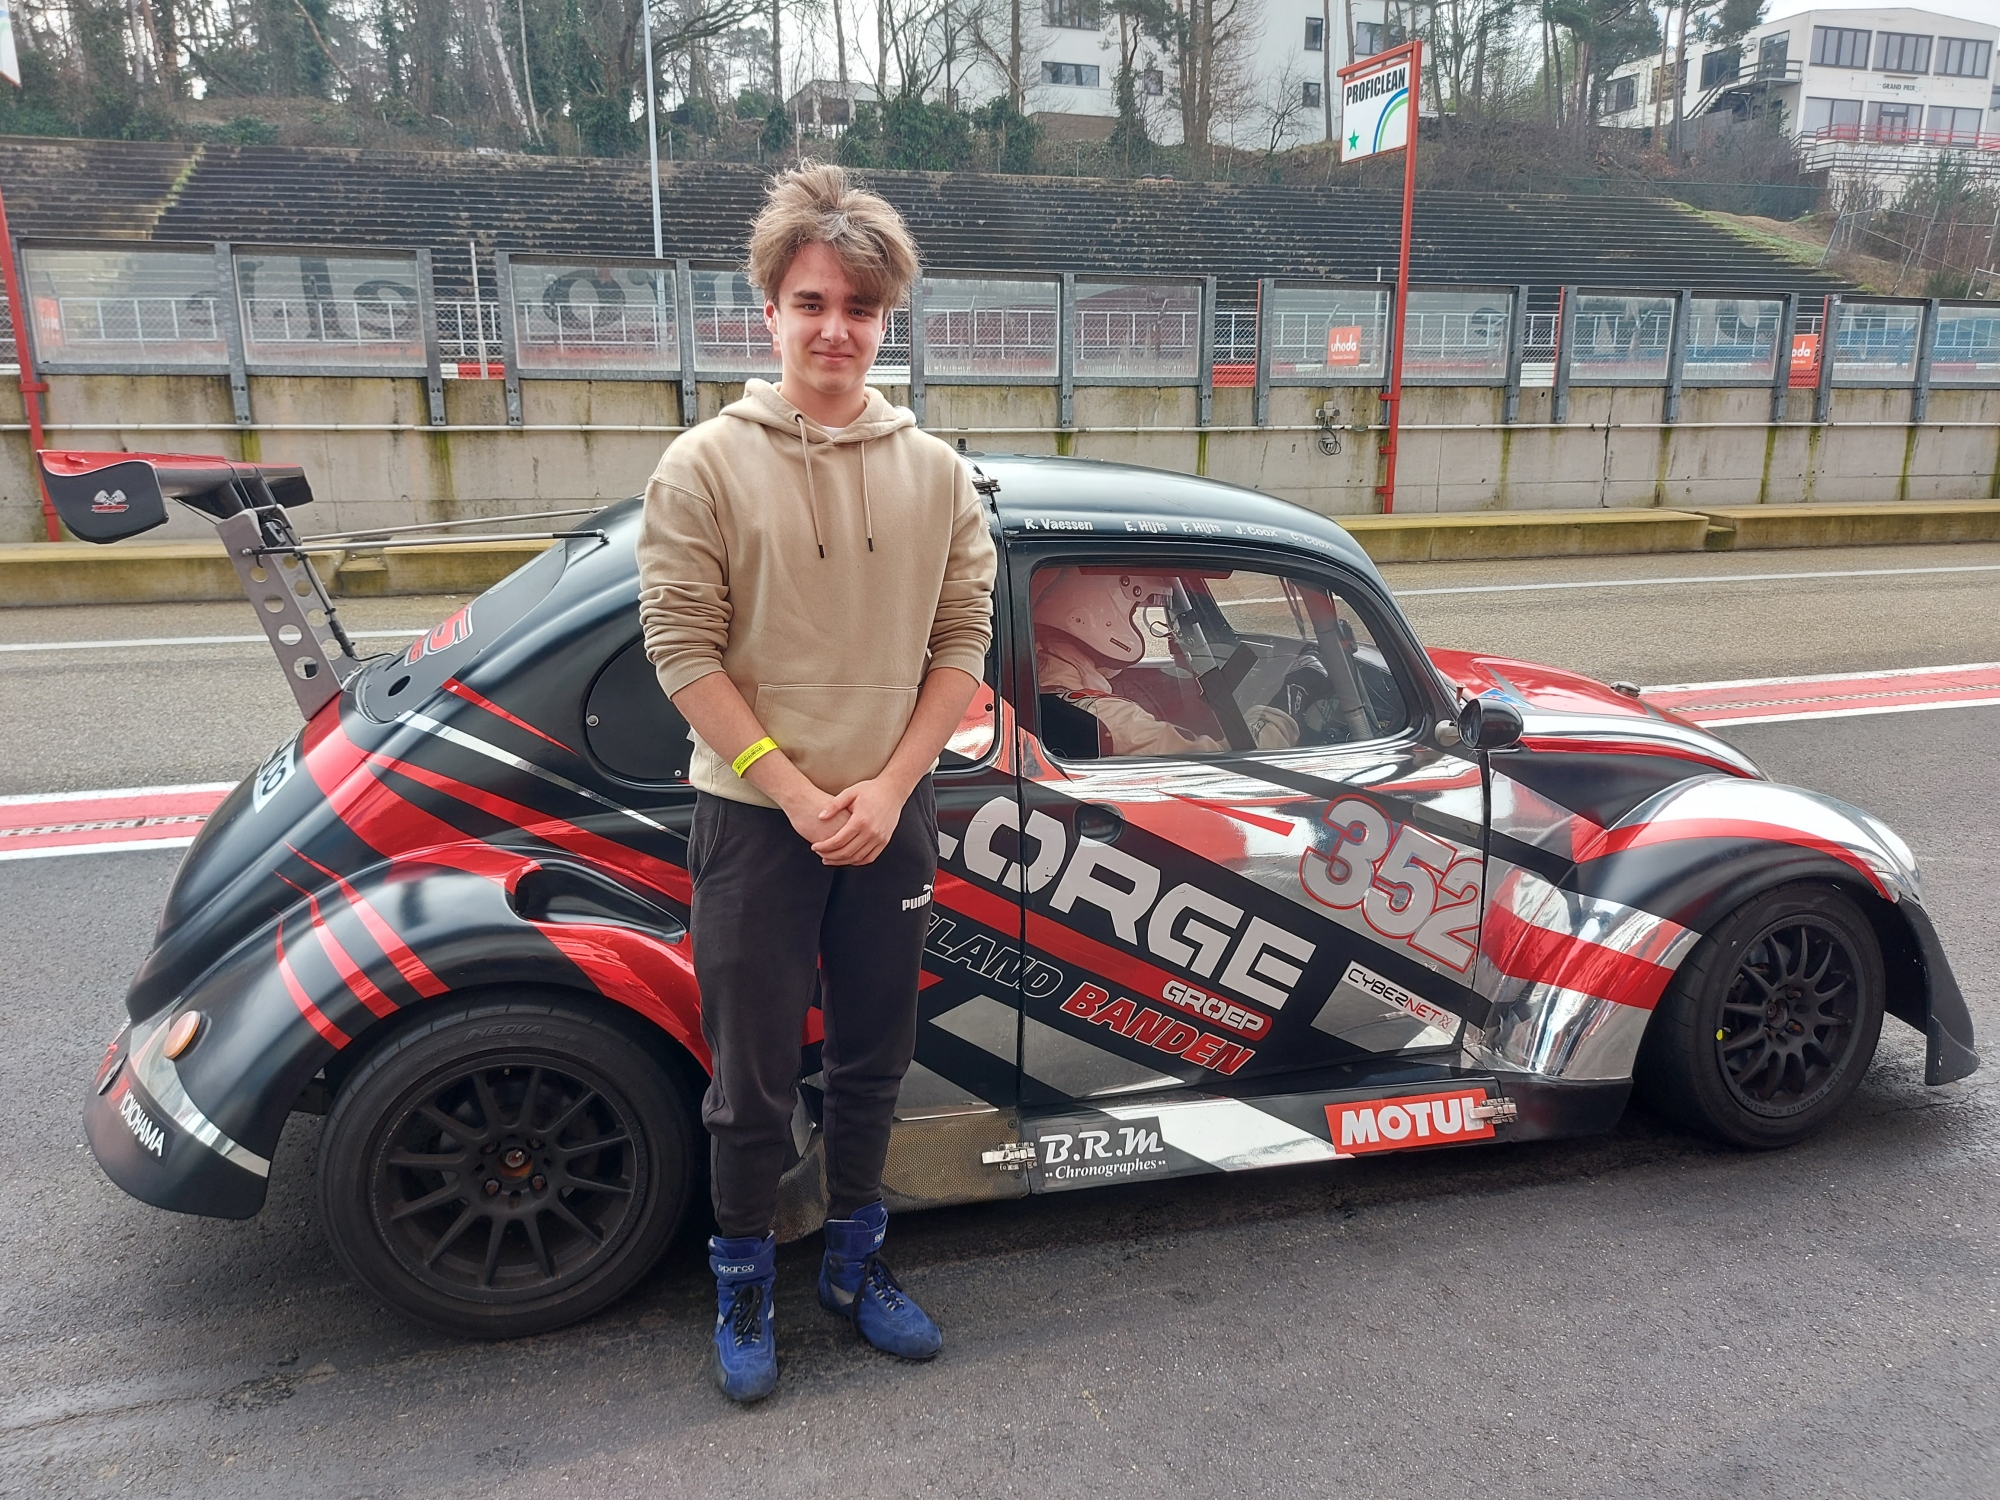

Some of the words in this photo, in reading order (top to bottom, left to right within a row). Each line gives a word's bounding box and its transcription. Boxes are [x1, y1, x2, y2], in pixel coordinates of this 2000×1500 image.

[1346, 67, 1406, 106] PROFICLEAN
[1882, 83, 1902, 91] GRAND
[1331, 333, 1357, 352] uhoda
[1792, 341, 1811, 357] oda
[1024, 518, 1039, 530] R.
[1040, 518, 1093, 531] Vaessen
[1123, 520, 1137, 532] E.
[1180, 521, 1192, 532] F.
[1235, 525, 1246, 535] J.
[1247, 526, 1278, 538] Coox
[1290, 532, 1302, 542] C.
[1303, 534, 1333, 550] Coox
[902, 890, 931, 911] PUMA
[938, 796, 1317, 1011] ORGE
[1299, 793, 1484, 975] 352
[924, 911, 1064, 999] LAND
[1059, 981, 1256, 1075] BANDEN
[1162, 979, 1265, 1033] GROEP
[119, 1088, 165, 1157] YOKOHAMA
[1341, 1096, 1485, 1146] MOTUL
[717, 1263, 755, 1275] sparco
